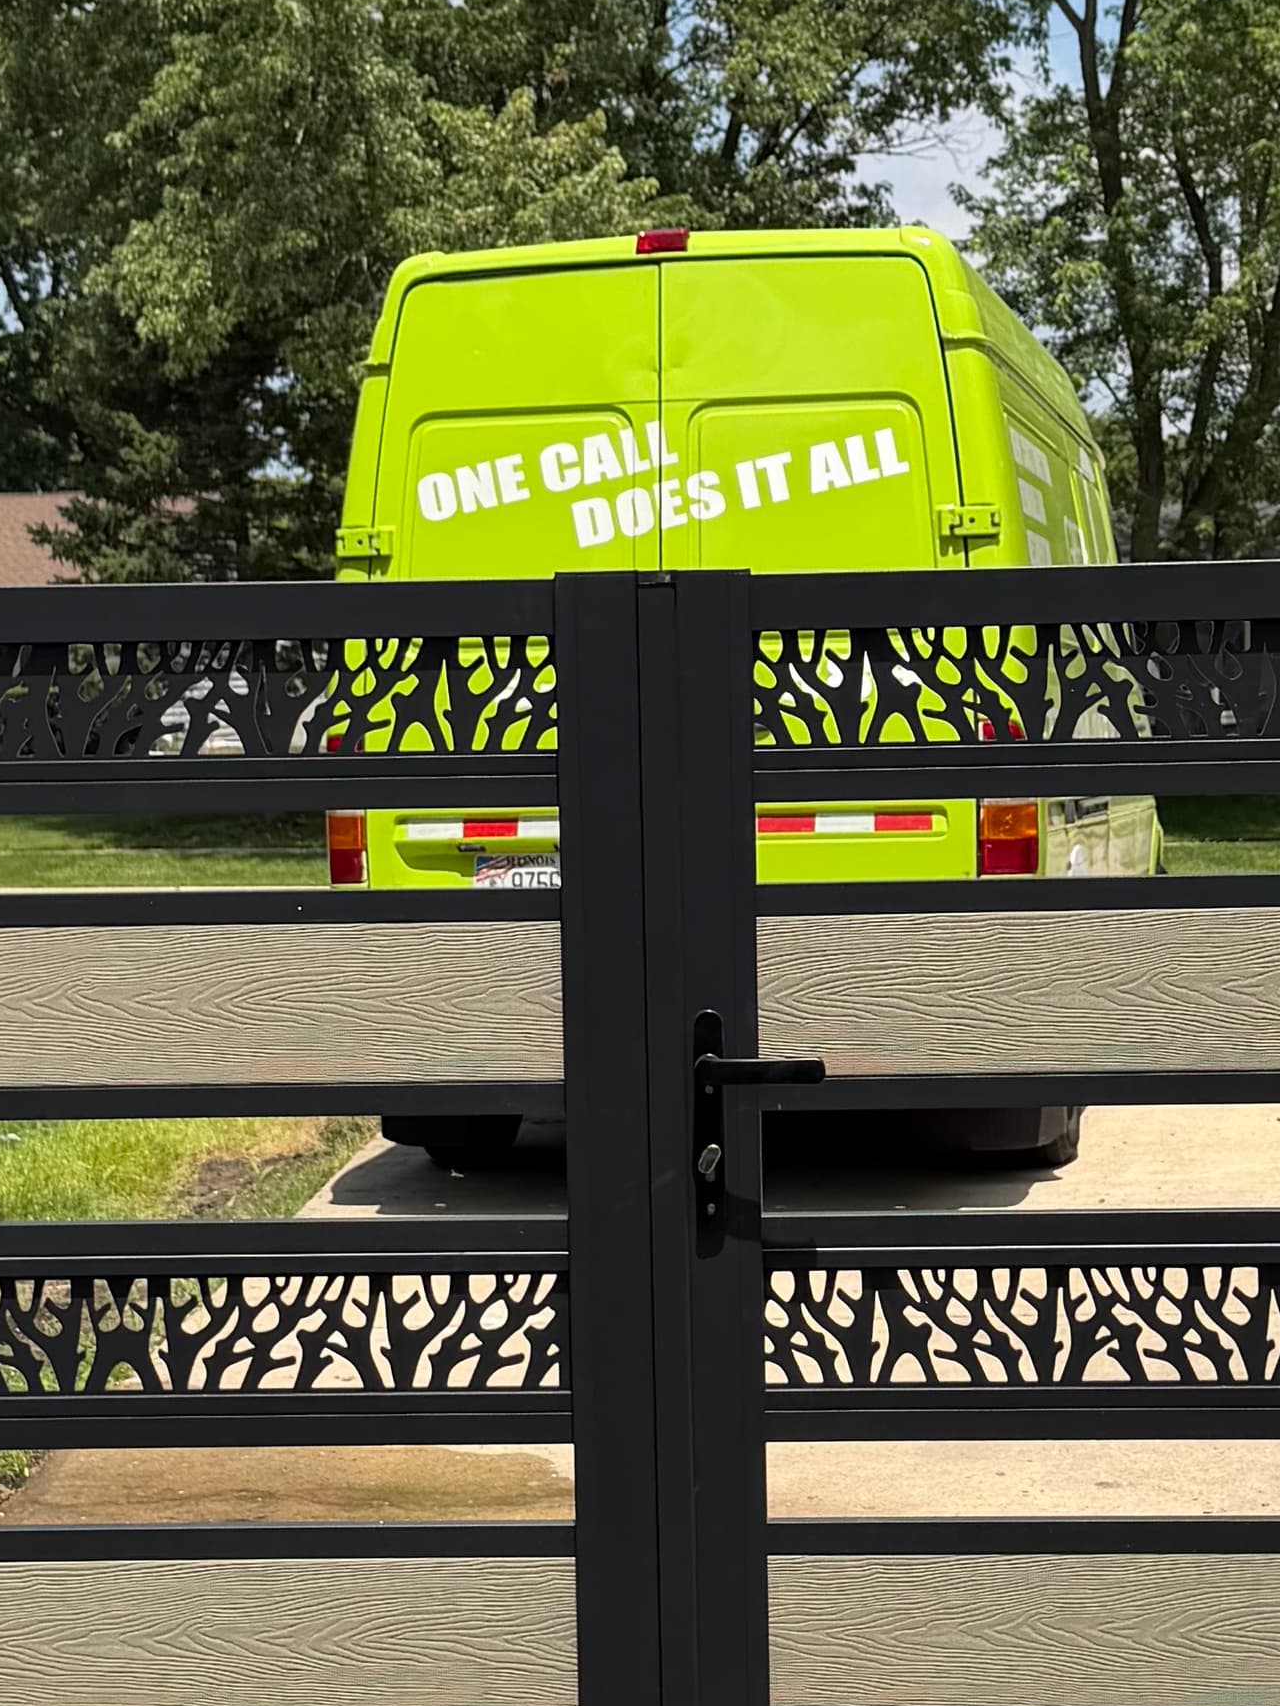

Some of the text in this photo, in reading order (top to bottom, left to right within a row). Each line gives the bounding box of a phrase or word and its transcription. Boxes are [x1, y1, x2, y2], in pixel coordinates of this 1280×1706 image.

[417, 420, 679, 522] ONE CALL
[571, 427, 910, 549] DOES IT ALL
